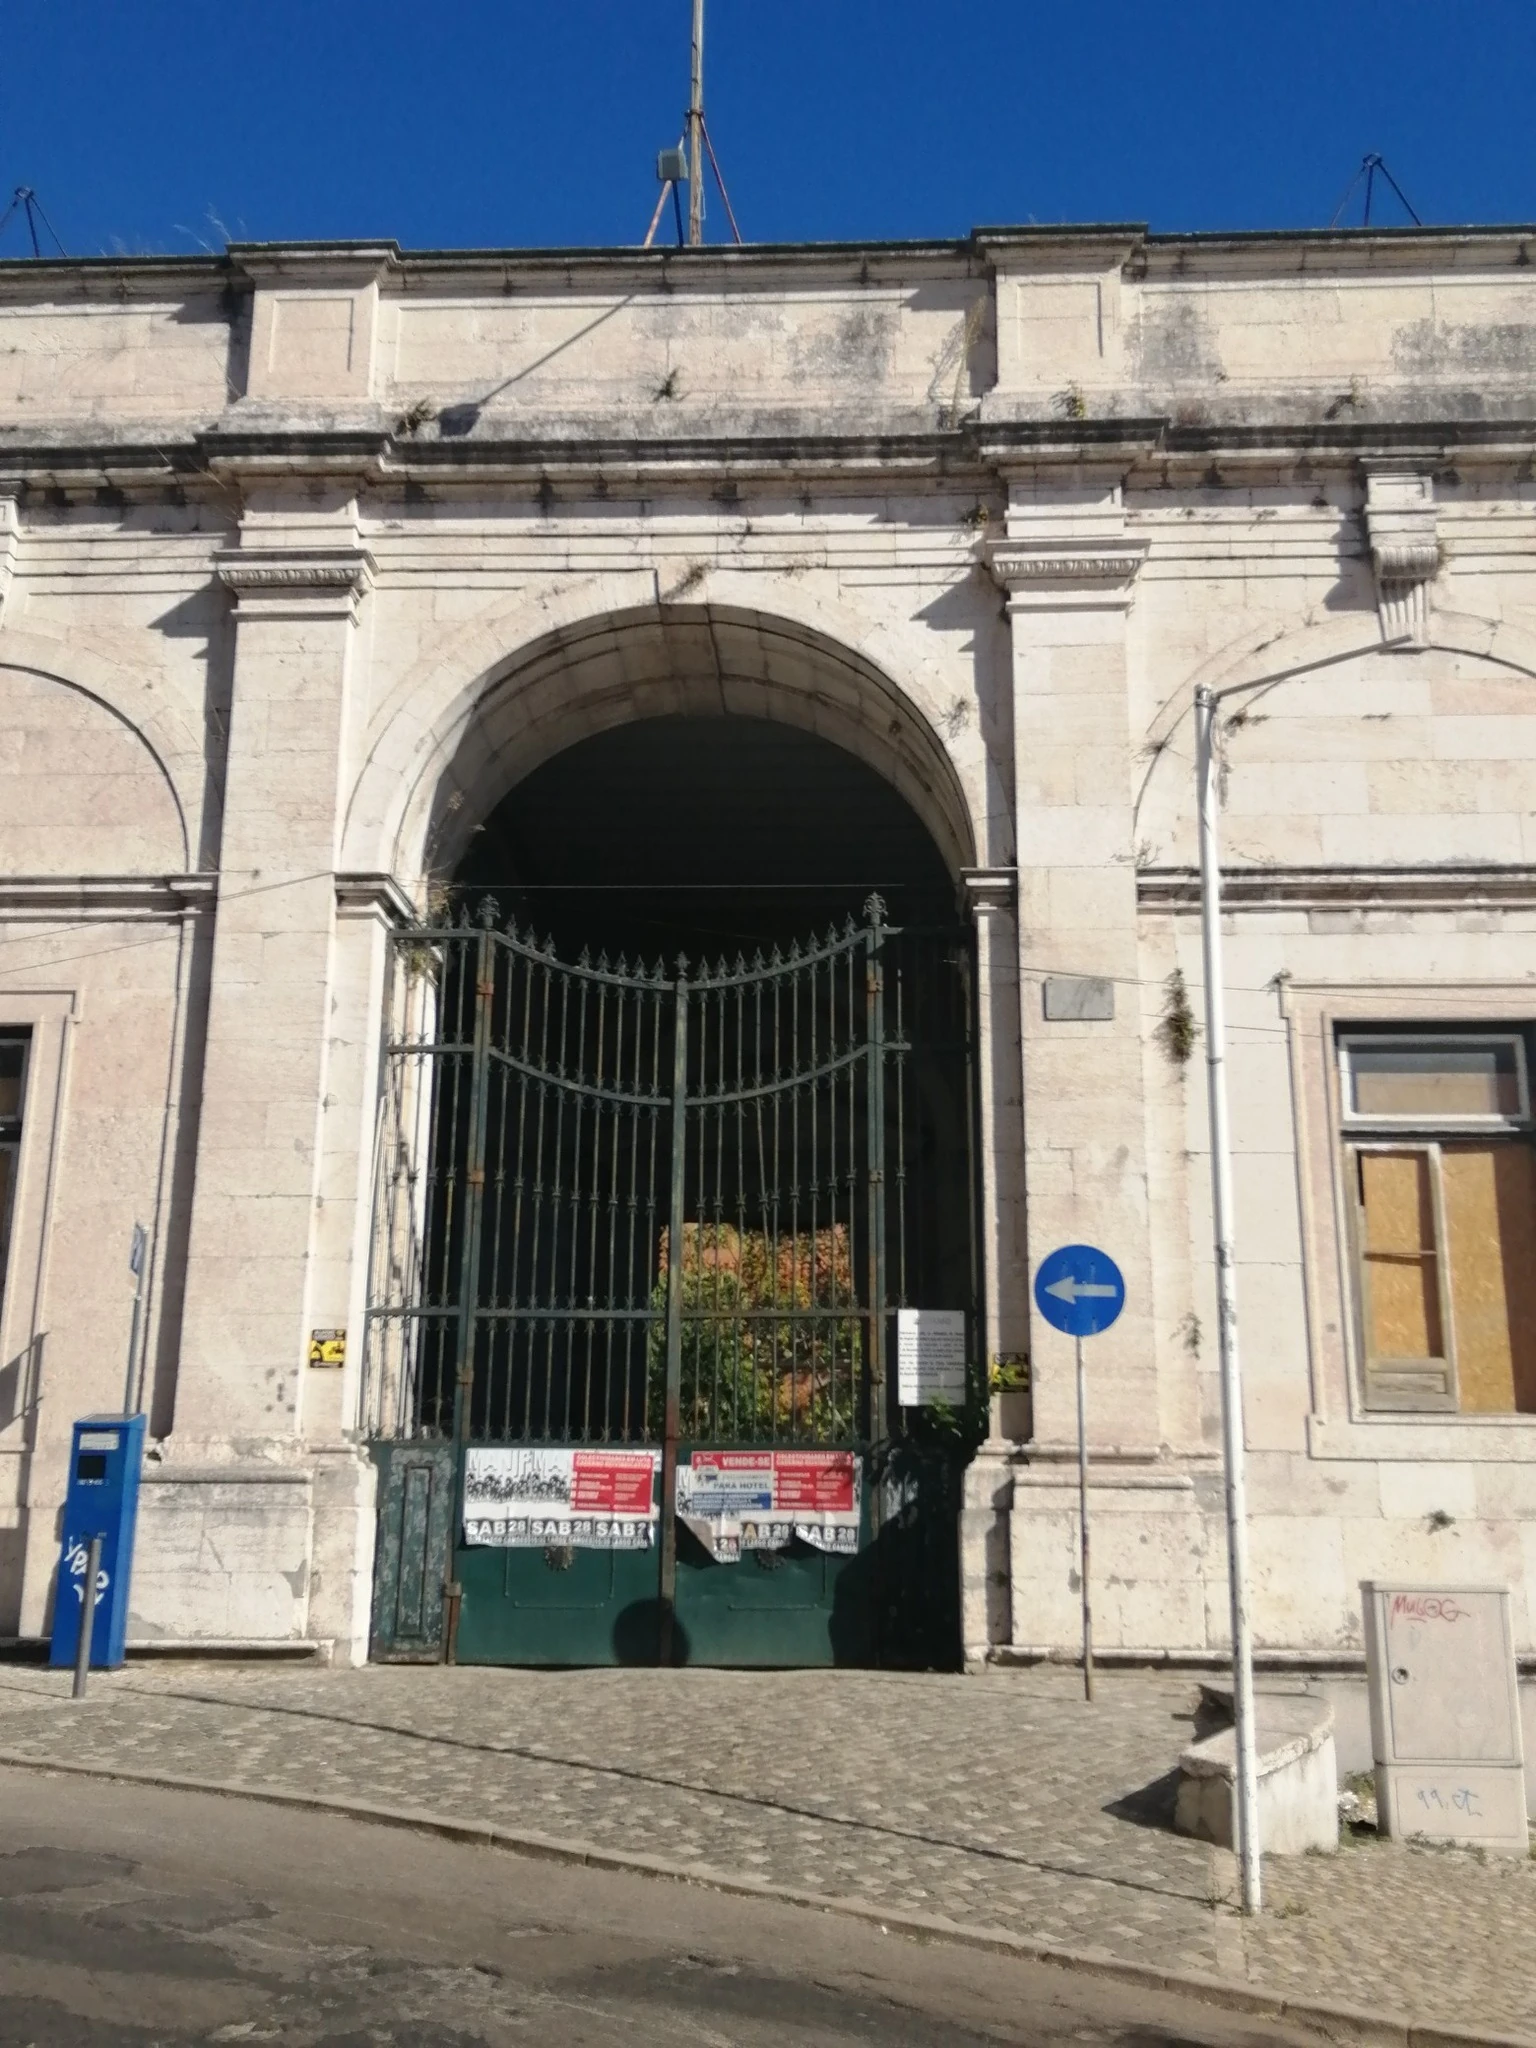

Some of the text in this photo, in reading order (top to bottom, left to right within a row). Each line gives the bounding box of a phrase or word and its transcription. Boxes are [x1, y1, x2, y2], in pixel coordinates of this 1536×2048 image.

[722, 1456, 770, 1467] VENDE-SE
[467, 1520, 526, 1535] SAB 28
[532, 1520, 591, 1536] SAB 28
[596, 1521, 647, 1537] SAB 2
[741, 1523, 770, 1539] AB
[796, 1524, 855, 1542] SAB 28
